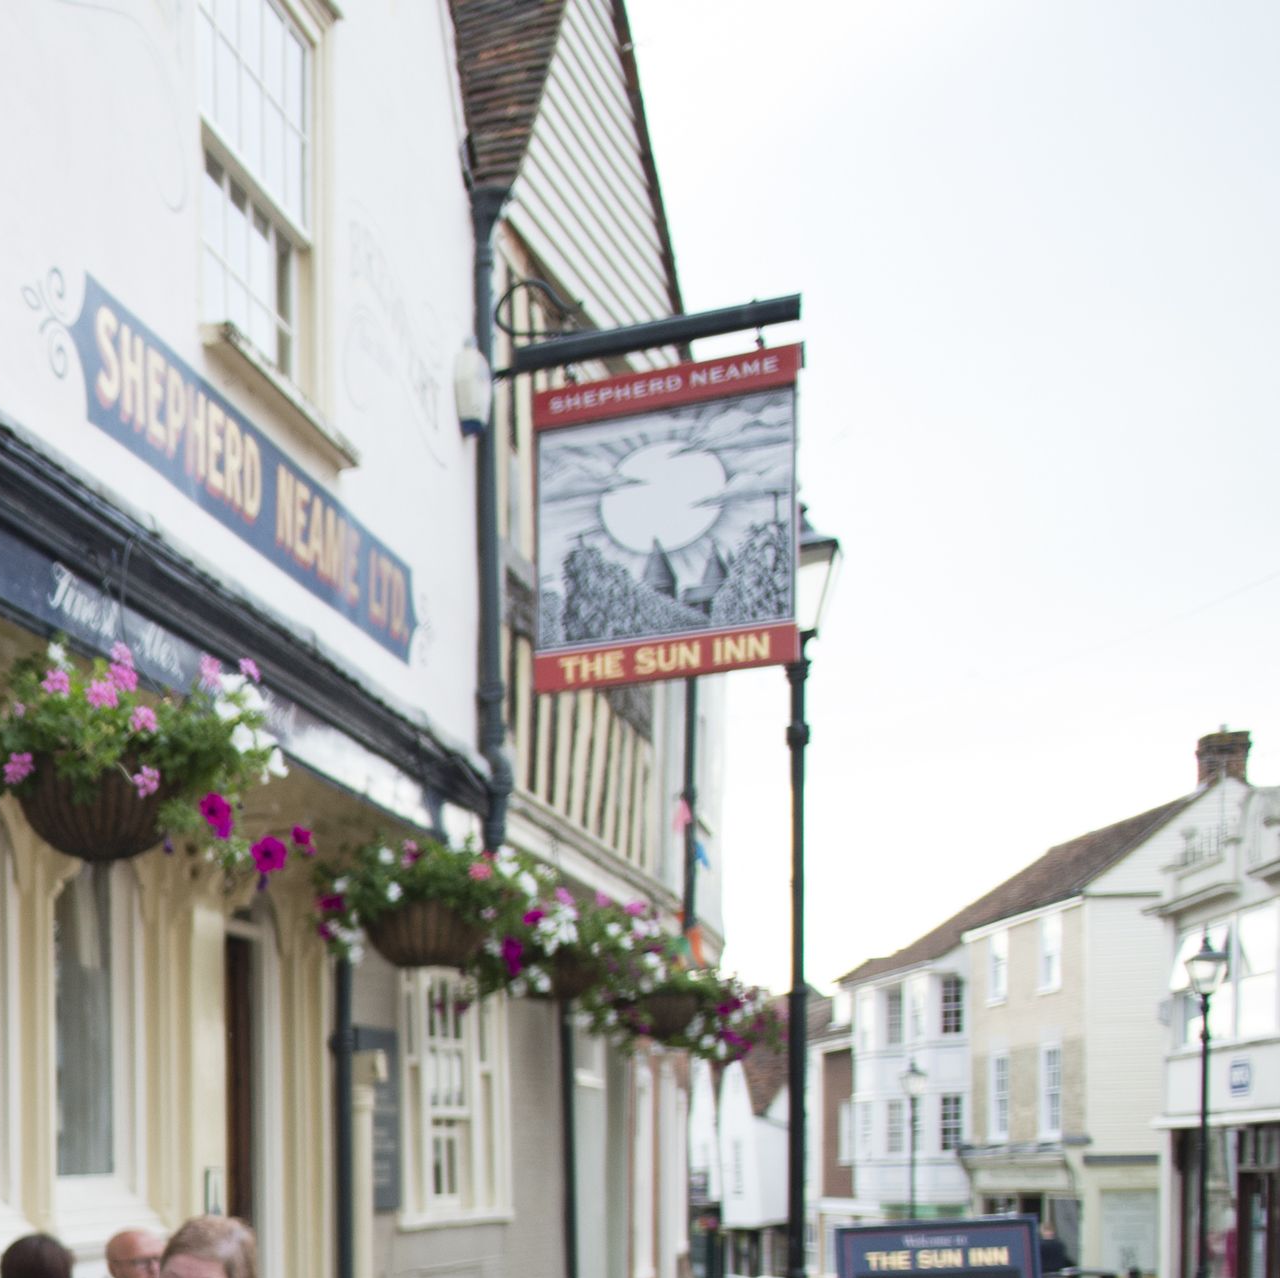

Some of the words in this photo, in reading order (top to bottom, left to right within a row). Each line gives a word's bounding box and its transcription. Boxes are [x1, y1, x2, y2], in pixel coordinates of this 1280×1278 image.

[548, 374, 683, 415] SHEPHERD
[689, 356, 779, 387] NEAME
[94, 303, 262, 525] SHEPHERD
[274, 461, 360, 607] NEAME
[557, 652, 625, 685] THE
[634, 641, 701, 676] SUN
[712, 632, 772, 666] INN
[865, 1250, 912, 1271] THE
[916, 1248, 963, 1269] SUN
[968, 1245, 1010, 1267] INN
